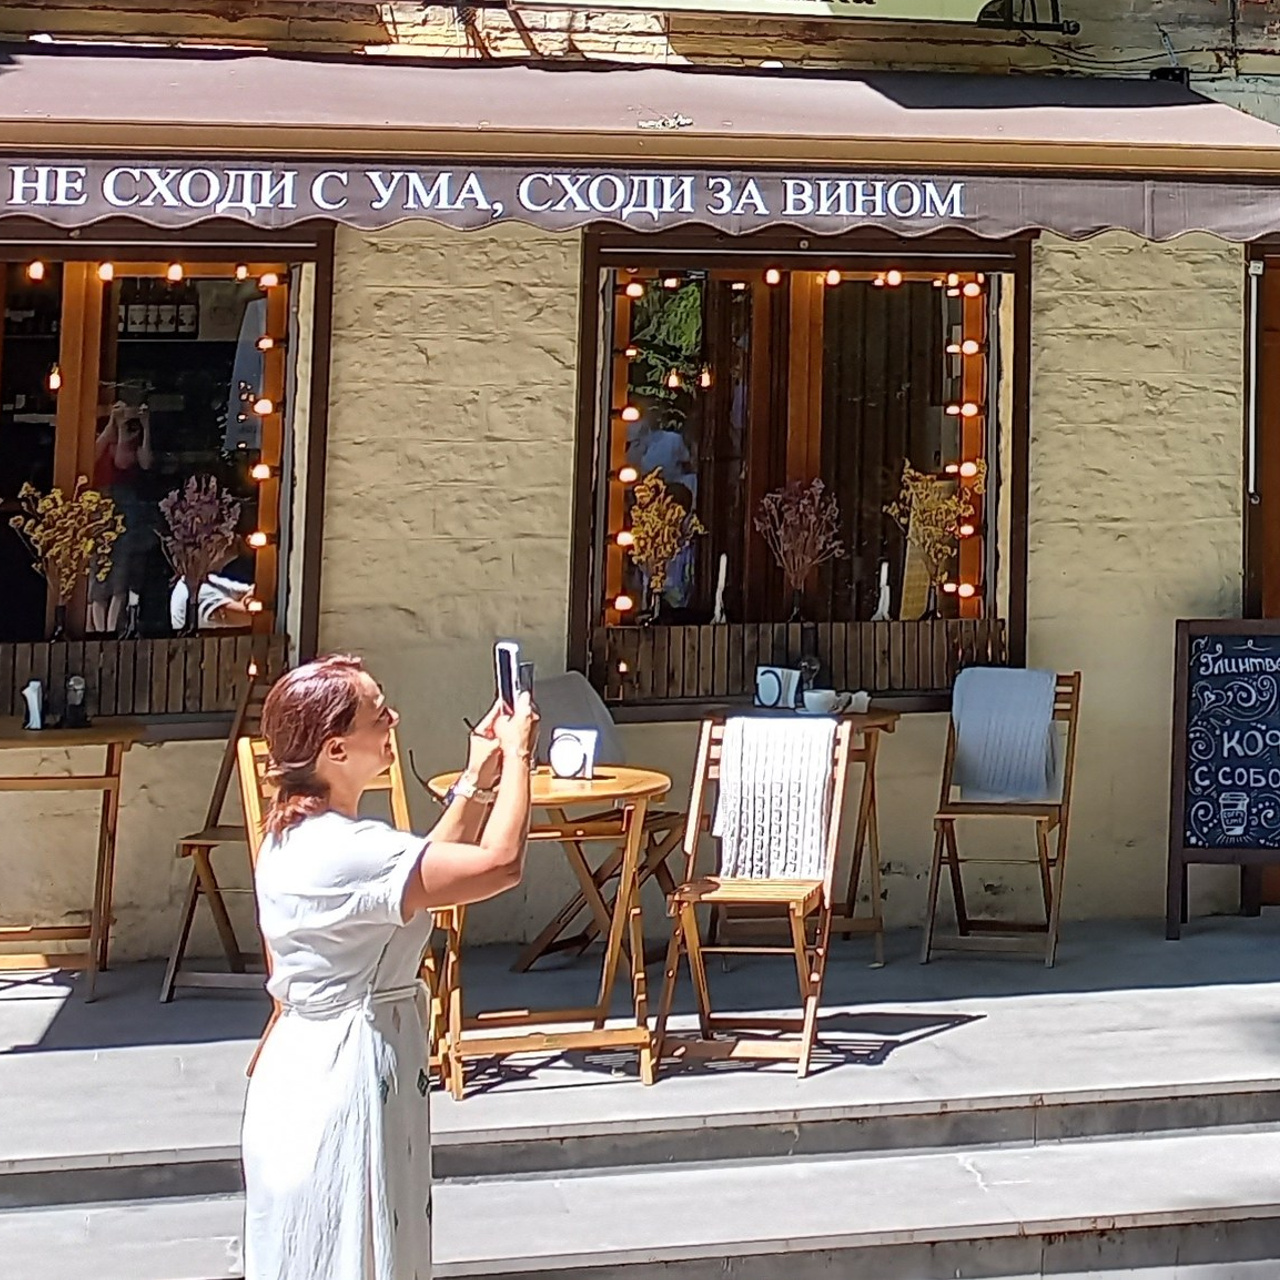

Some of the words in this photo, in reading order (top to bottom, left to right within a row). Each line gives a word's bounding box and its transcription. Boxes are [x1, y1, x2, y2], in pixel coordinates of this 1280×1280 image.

[7, 166, 87, 206] НЕ
[102, 167, 298, 218] СХОДИ
[310, 171, 349, 210] С
[364, 172, 505, 221] УМА,
[519, 173, 694, 220] СХОДИ
[706, 179, 770, 215] ЗА
[782, 179, 965, 218] ВИНОМ
